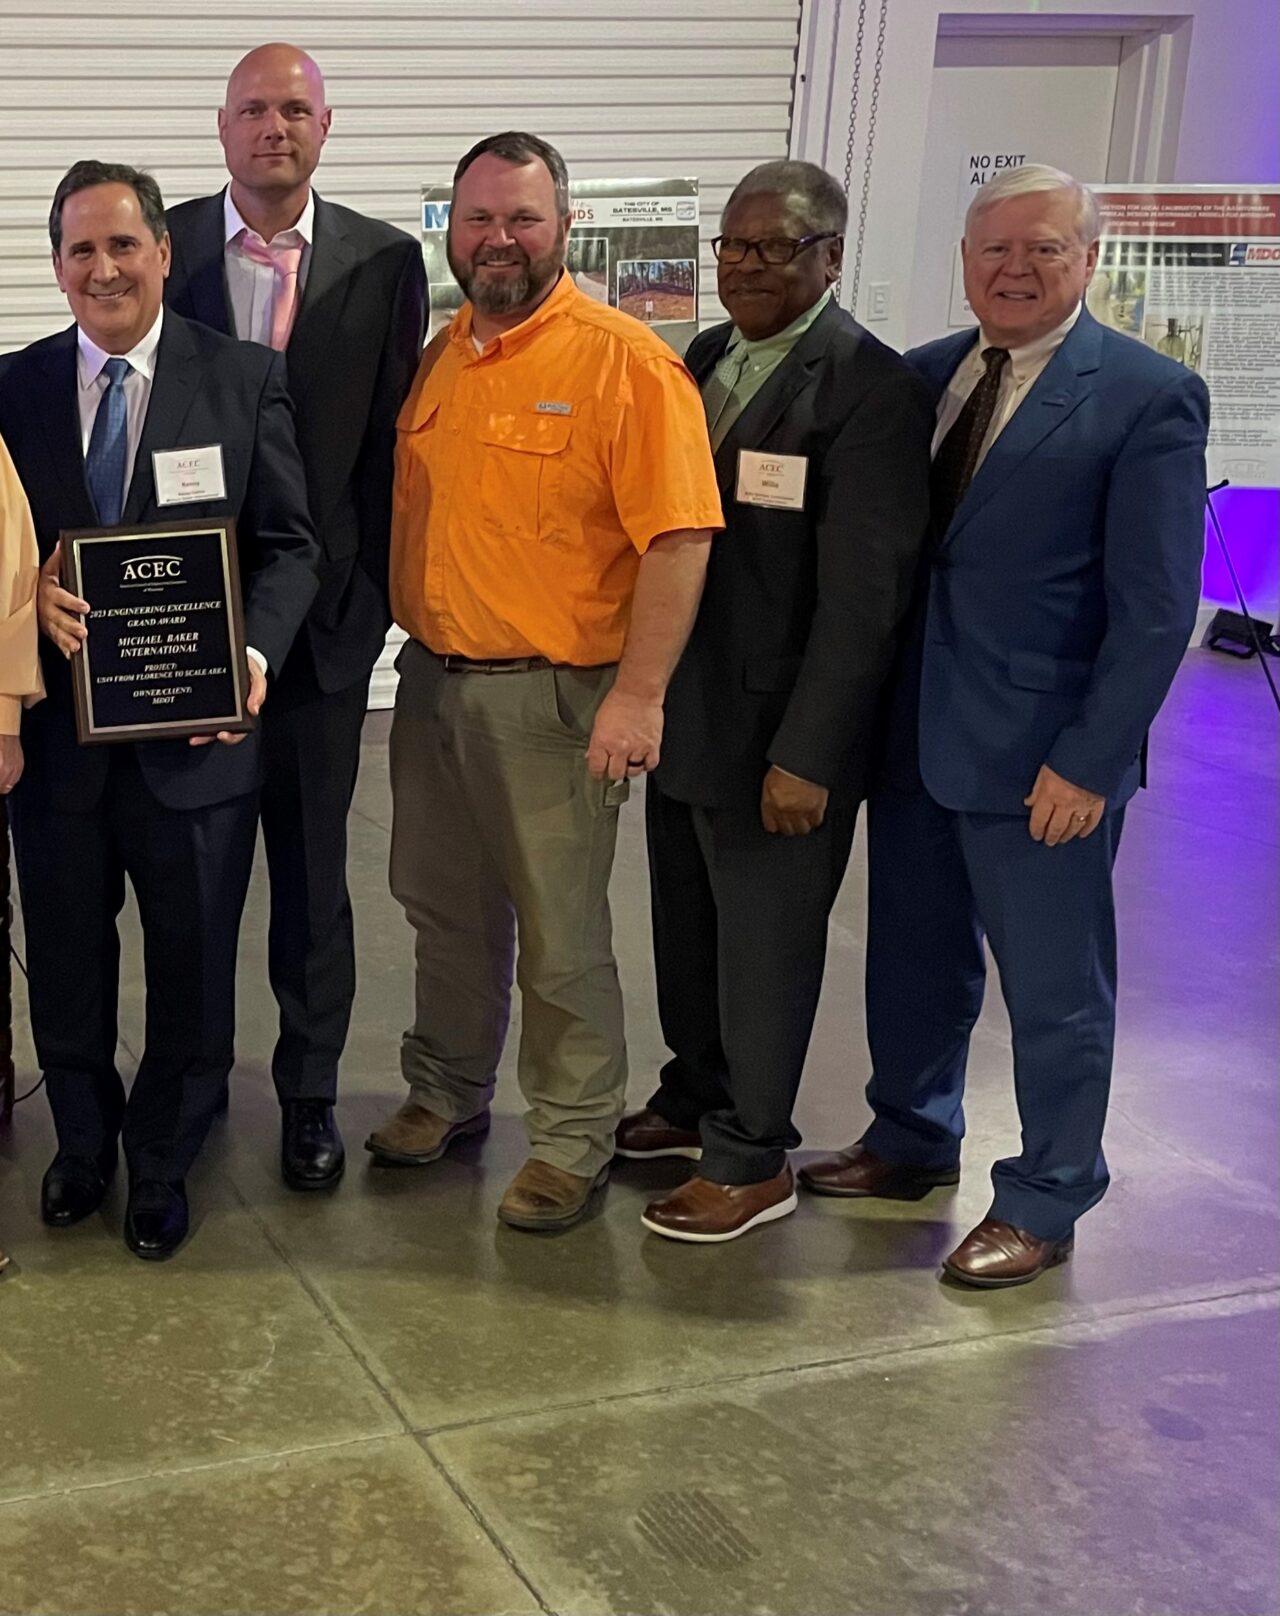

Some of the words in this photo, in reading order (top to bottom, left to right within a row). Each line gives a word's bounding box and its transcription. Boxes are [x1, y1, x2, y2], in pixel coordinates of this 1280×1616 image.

[970, 155, 990, 168] NO
[995, 154, 1026, 168] EXIT
[123, 560, 181, 580] ACEC
[108, 605, 166, 617] ENGINEERING
[167, 600, 222, 613] EXCELLENCE
[127, 618, 157, 628] GRAND
[157, 616, 186, 625] AWARD
[118, 635, 163, 647] MICHAEL
[167, 632, 199, 643] BAKER
[120, 643, 198, 658] INTERNATIONAL
[114, 674, 135, 682] FROM
[136, 671, 173, 680] FLORENCE
[174, 670, 184, 678] TO
[184, 669, 207, 677] SCALE
